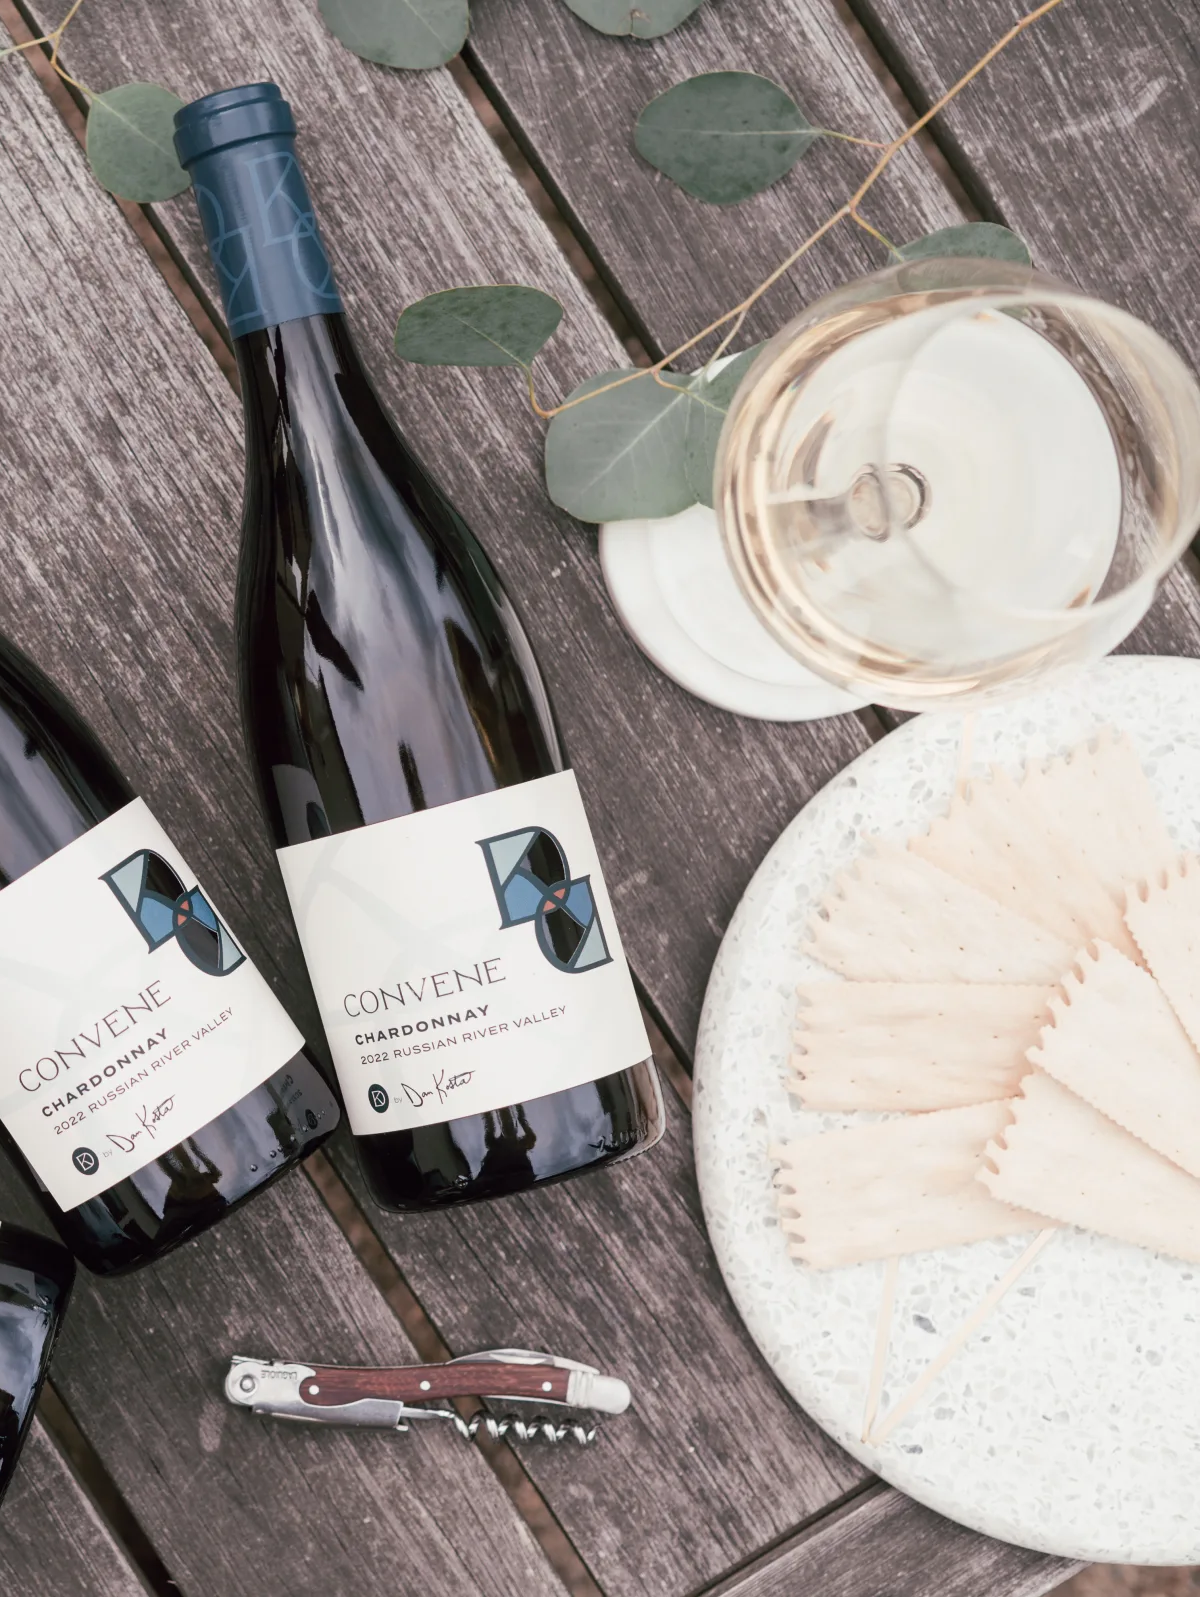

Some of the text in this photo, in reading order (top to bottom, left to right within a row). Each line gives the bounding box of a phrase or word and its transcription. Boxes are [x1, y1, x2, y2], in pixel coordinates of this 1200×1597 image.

[343, 957, 506, 1018] CONVENE
[19, 980, 171, 1092] CONVENE
[355, 1004, 488, 1046] CHARDONNAY
[360, 1005, 566, 1065] 2022 RUSSIAN RIVER VALLEY
[41, 1028, 167, 1117] CHARDONNAY
[54, 1007, 232, 1135] 2022 RUSSIAN RIVER VALLEY
[393, 1095, 404, 1106] by
[102, 1148, 114, 1159] by
